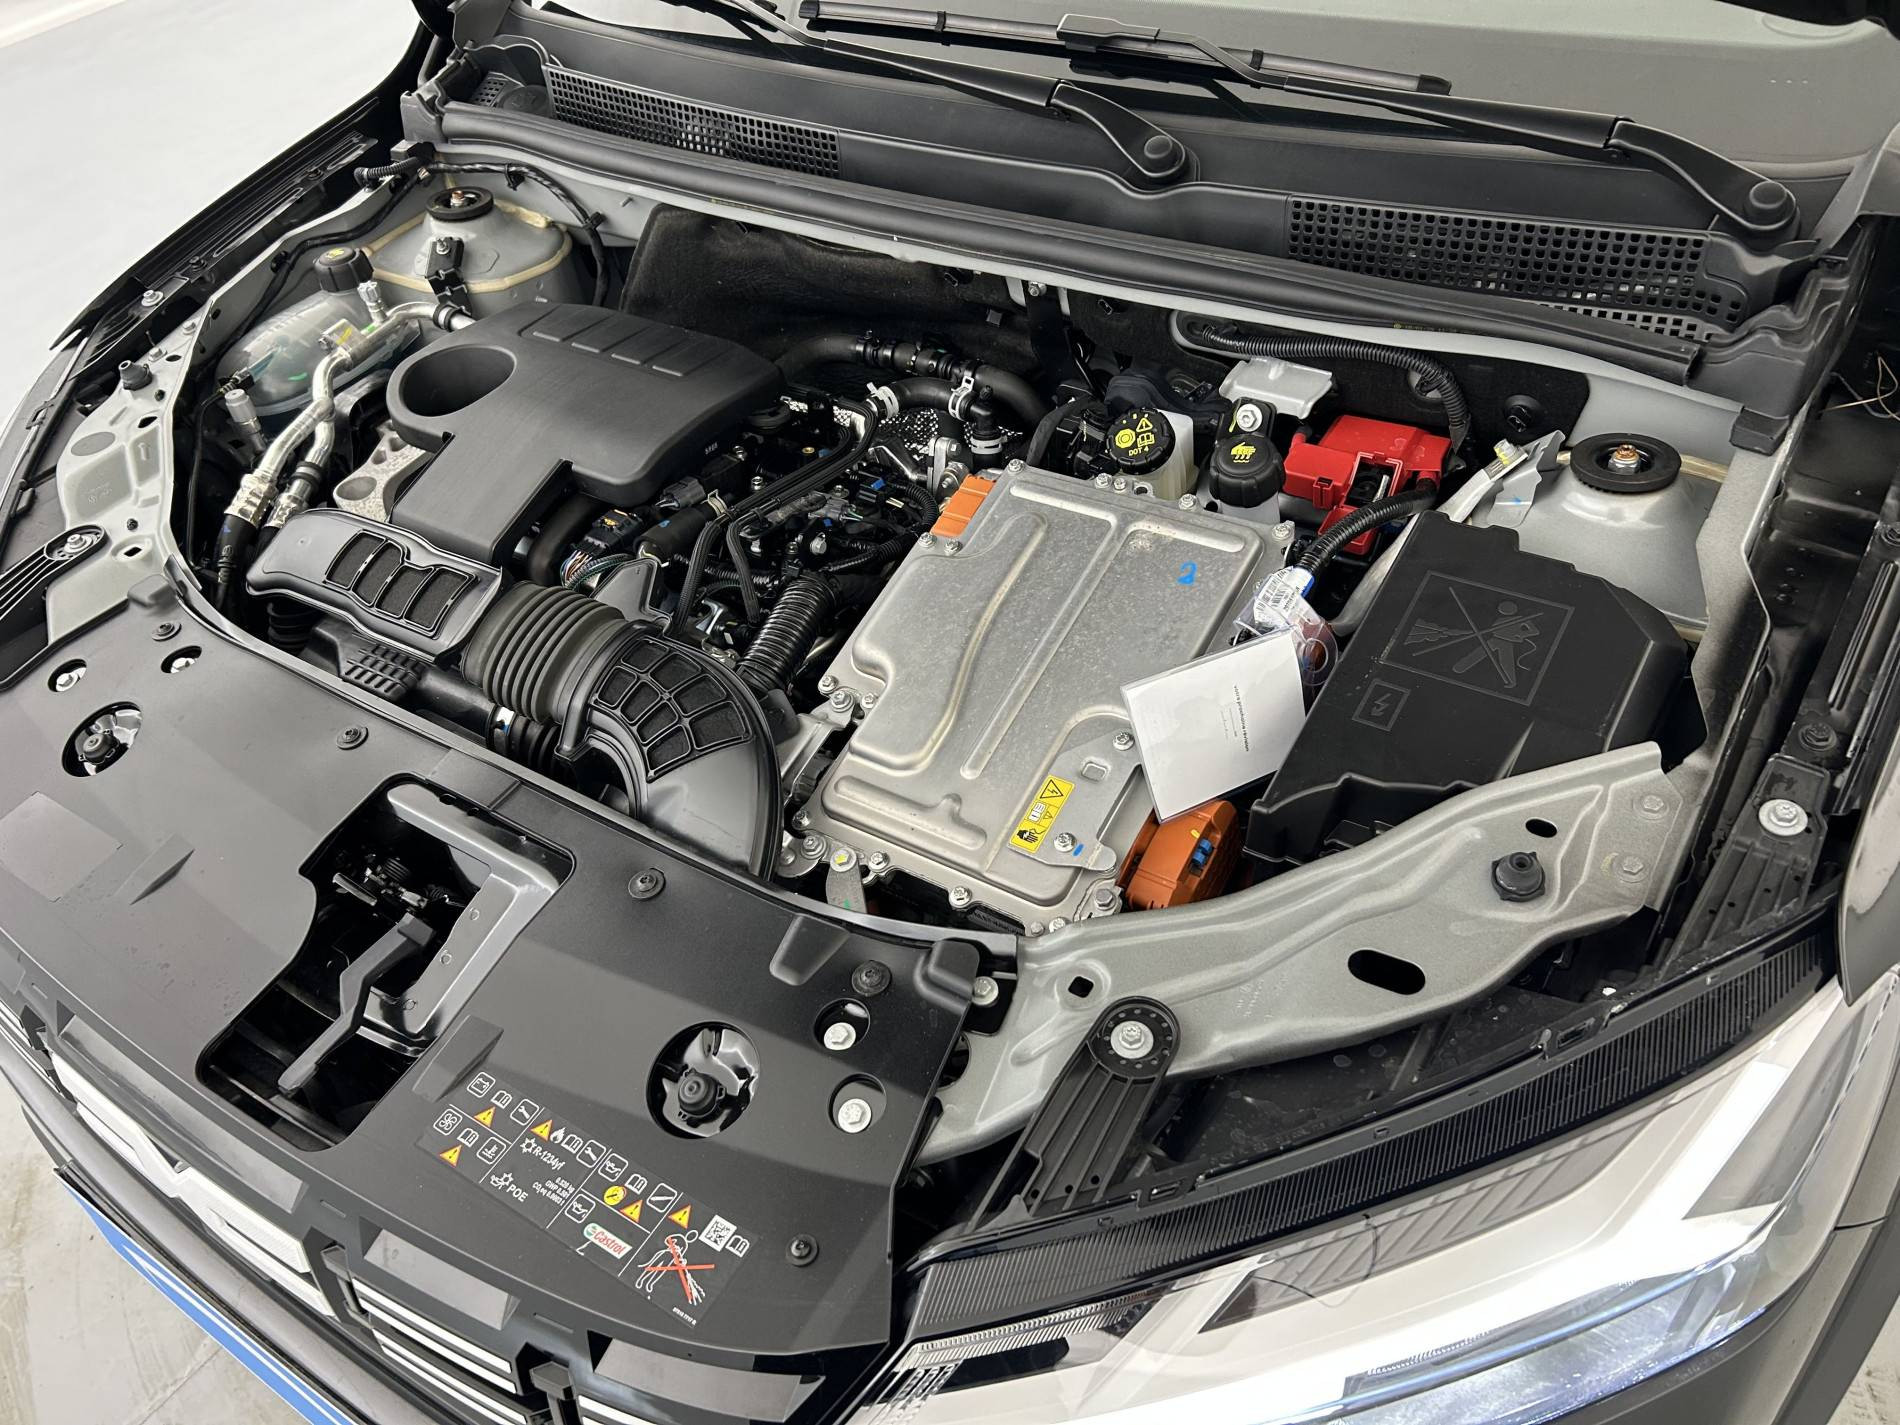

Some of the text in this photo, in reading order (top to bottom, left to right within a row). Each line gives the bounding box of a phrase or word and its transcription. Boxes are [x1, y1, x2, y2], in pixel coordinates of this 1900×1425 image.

[1129, 447, 1142, 456] DOT
[533, 1146, 565, 1170] R-1234yf
[506, 1184, 528, 1202] POE
[545, 1180, 558, 1190] GWP
[594, 1231, 626, 1254] Castrol
